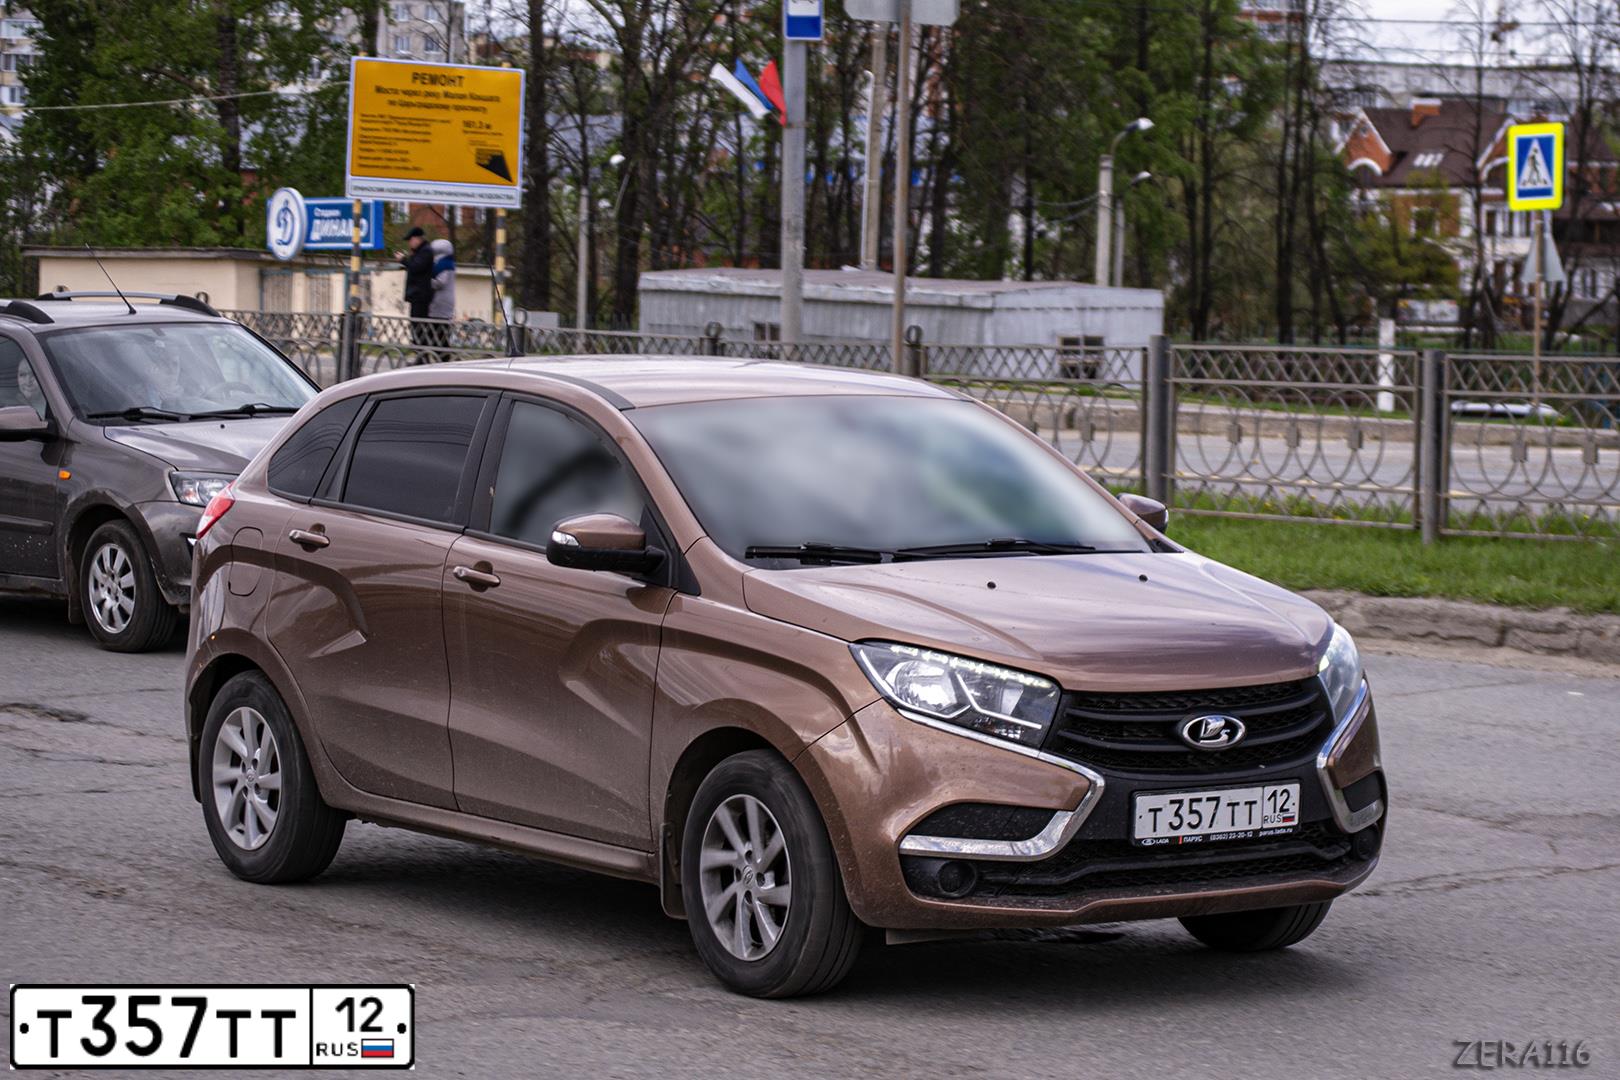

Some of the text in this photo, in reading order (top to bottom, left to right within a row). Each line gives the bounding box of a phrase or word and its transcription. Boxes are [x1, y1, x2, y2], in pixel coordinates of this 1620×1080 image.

[411, 71, 465, 88] РЕМОНТ
[1267, 788, 1291, 814] 12
[1263, 814, 1282, 824] RUS
